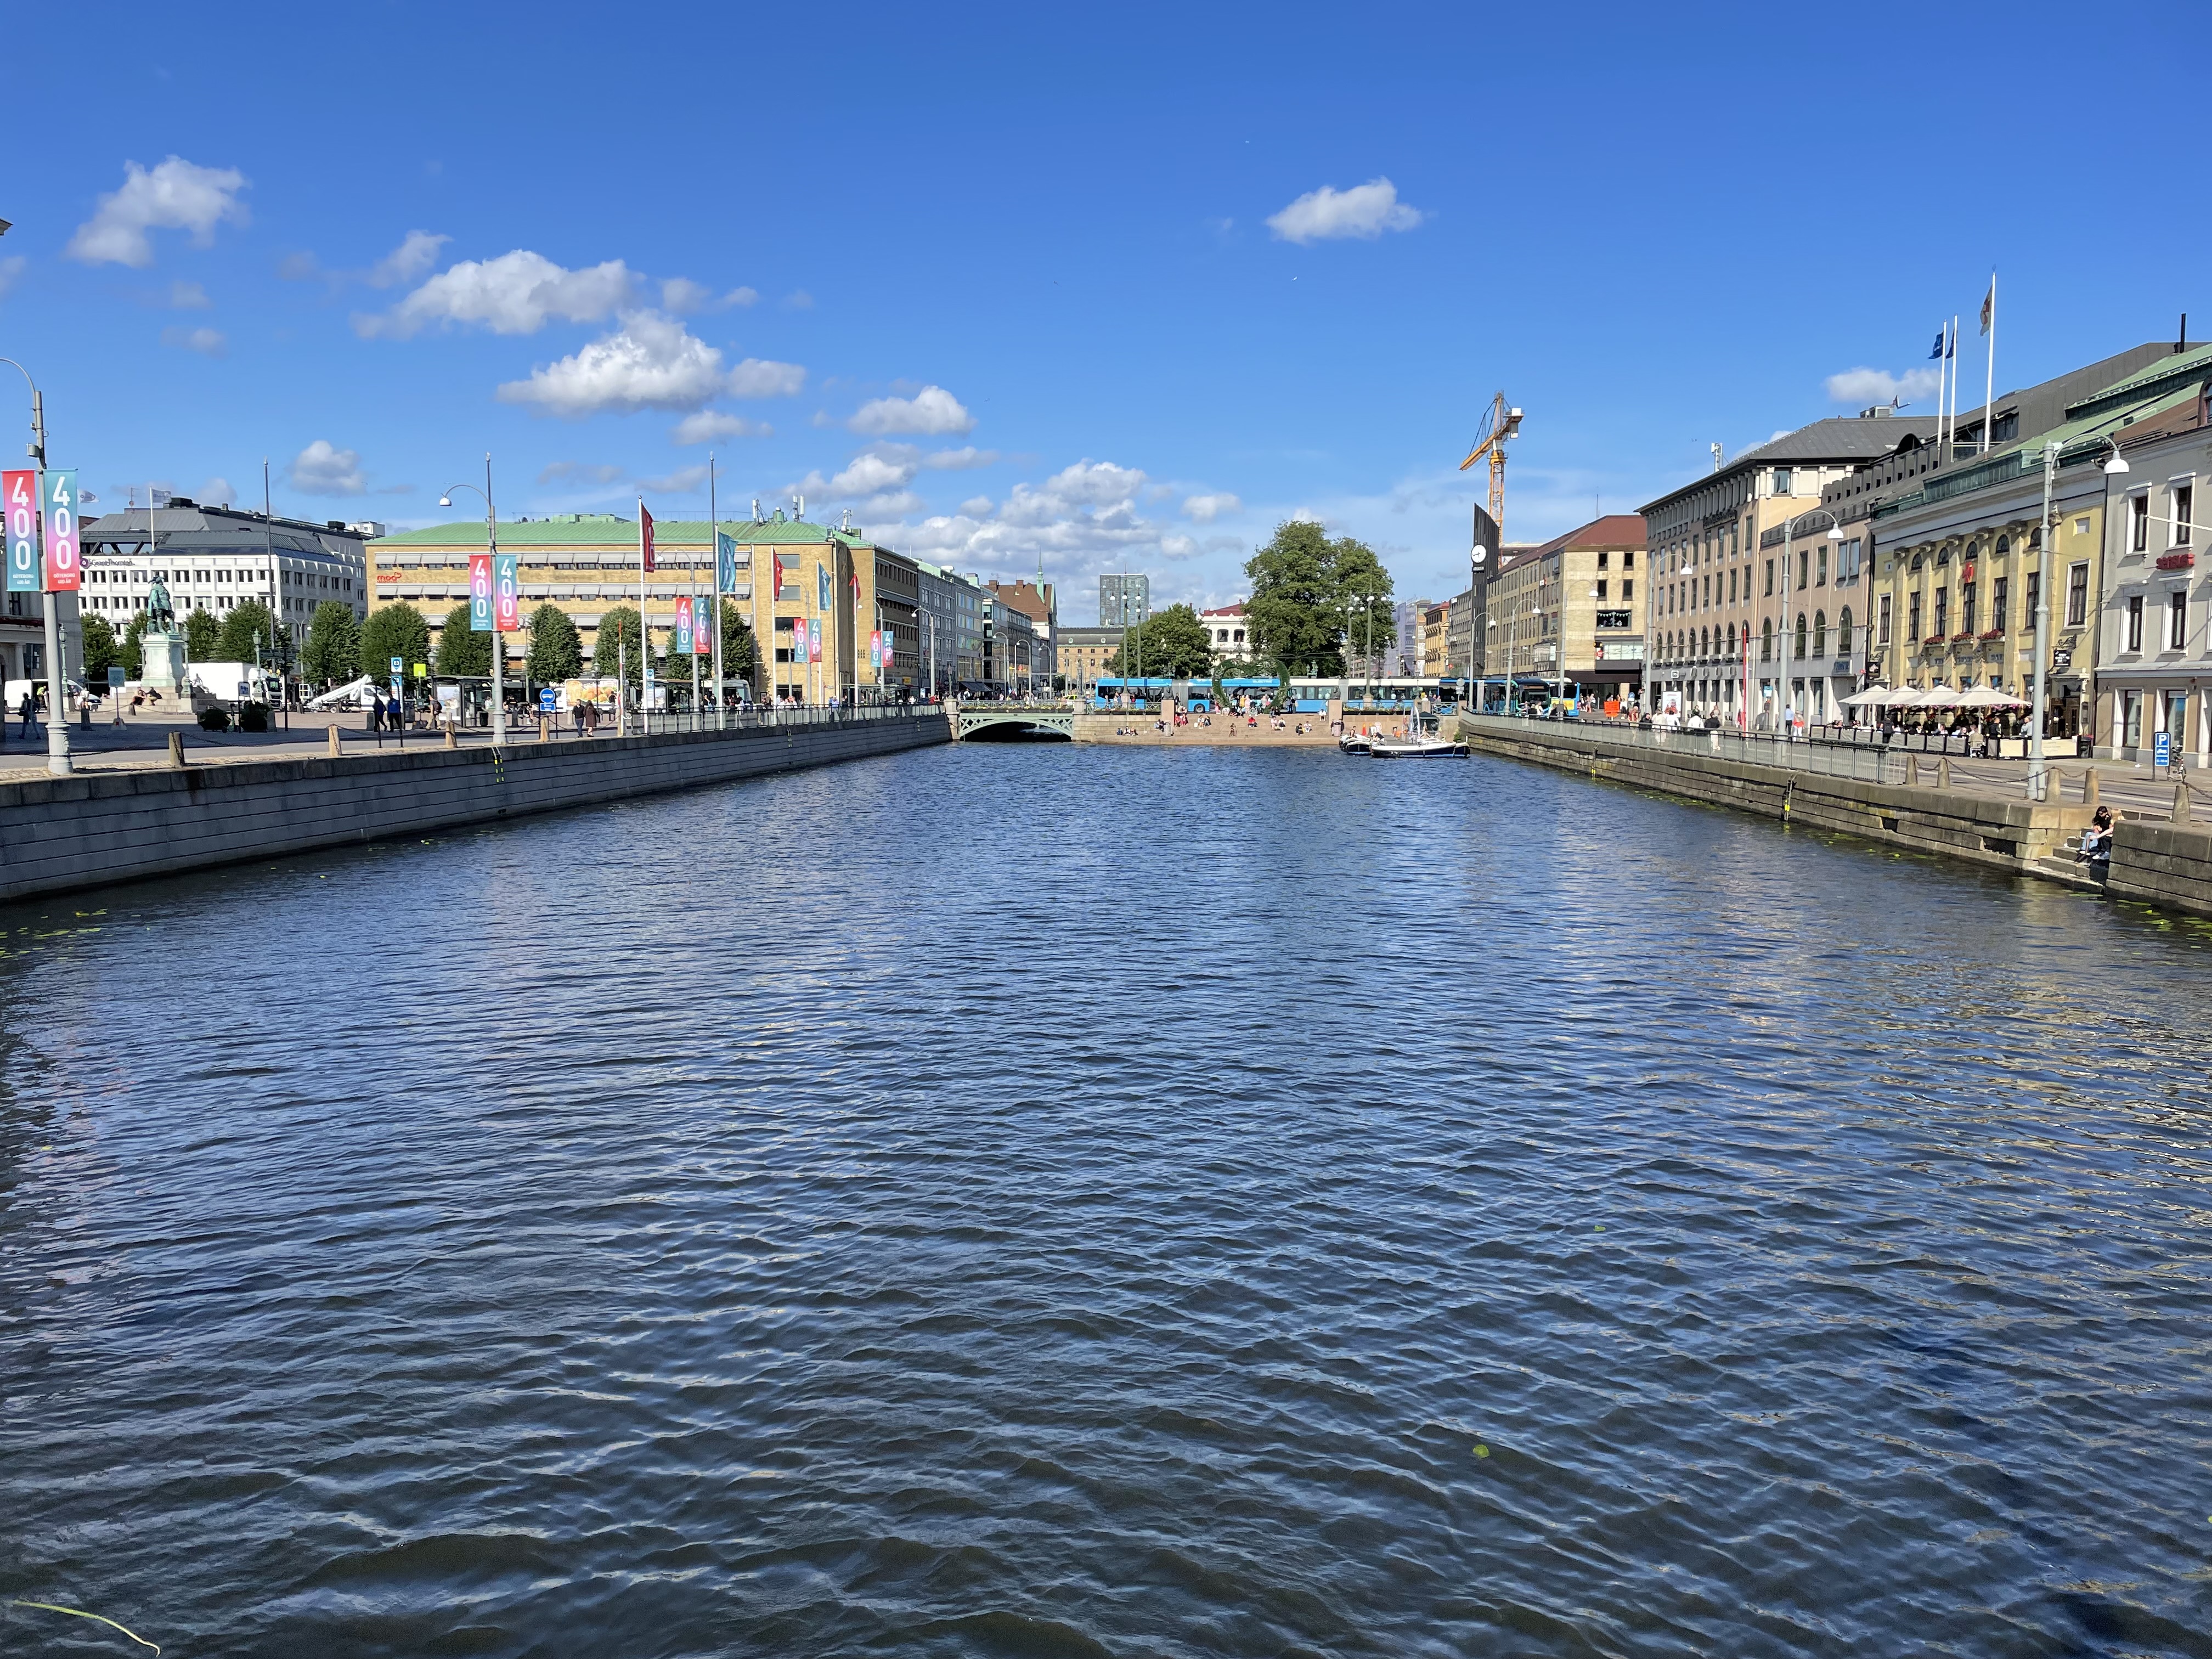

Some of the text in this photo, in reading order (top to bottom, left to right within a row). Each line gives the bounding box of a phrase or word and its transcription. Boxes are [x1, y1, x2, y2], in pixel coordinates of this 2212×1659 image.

[12, 477, 31, 570] 400
[53, 476, 72, 569] 400
[475, 559, 487, 618] 400
[500, 559, 512, 617] 400
[680, 601, 689, 644] 400
[698, 603, 707, 644] 400
[2159, 734, 2167, 746] P
